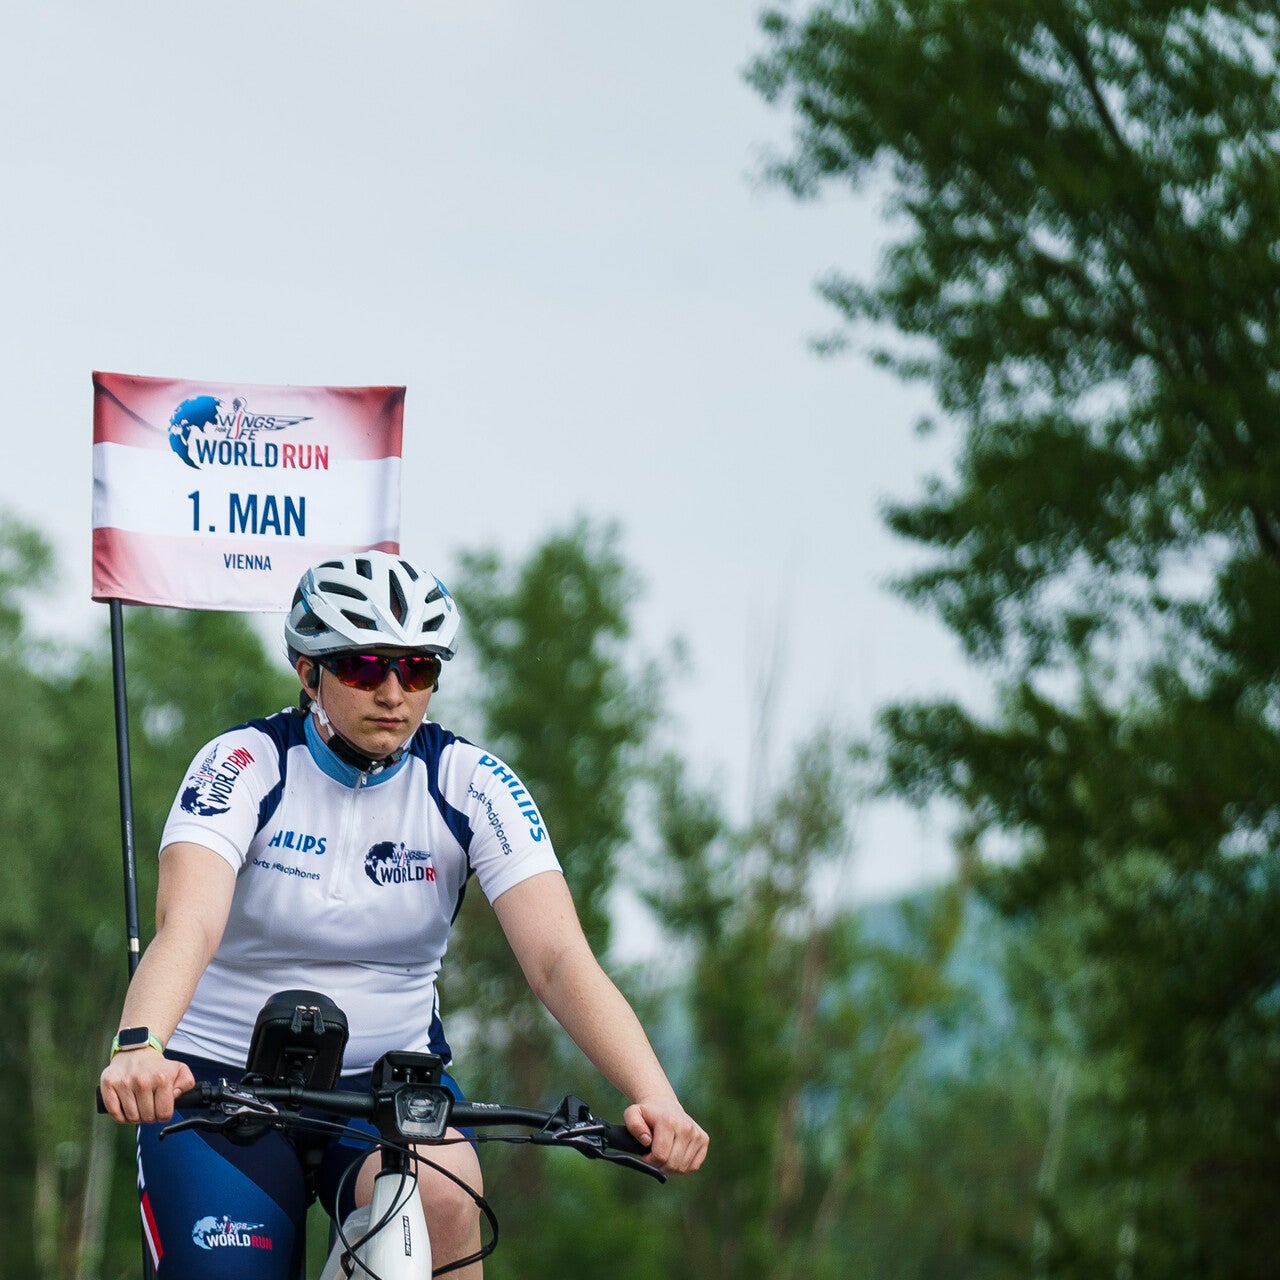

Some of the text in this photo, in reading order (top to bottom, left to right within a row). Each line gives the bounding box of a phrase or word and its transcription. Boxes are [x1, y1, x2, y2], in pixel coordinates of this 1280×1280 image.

[218, 413, 276, 430] WINGS
[226, 428, 259, 441] LIFE
[187, 491, 306, 537] 1. MAN
[223, 552, 272, 571] VIENNA
[478, 755, 546, 842] PHILIPS
